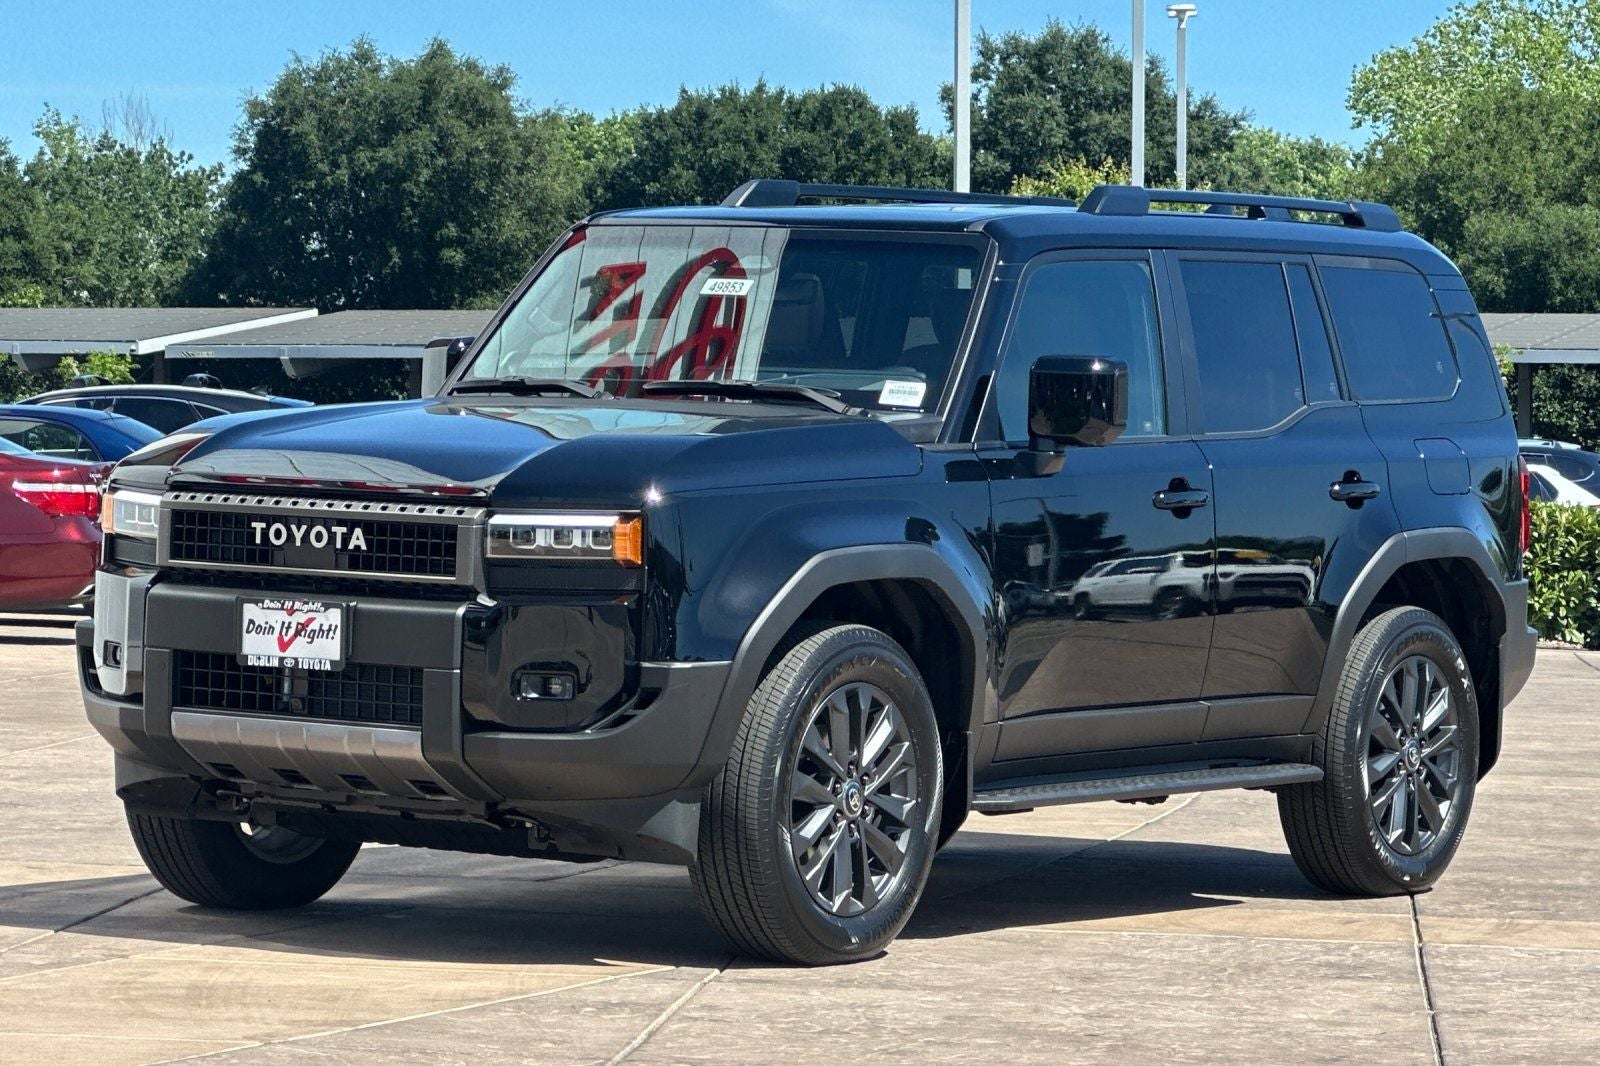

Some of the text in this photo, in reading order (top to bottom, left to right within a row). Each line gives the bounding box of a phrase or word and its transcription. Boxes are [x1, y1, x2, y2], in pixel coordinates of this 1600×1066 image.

[708, 281, 745, 294] 49853
[251, 522, 367, 551] TOYOTA
[245, 618, 338, 645] Doin' It Right!
[247, 654, 331, 671] DUBLIN TOYOTA
